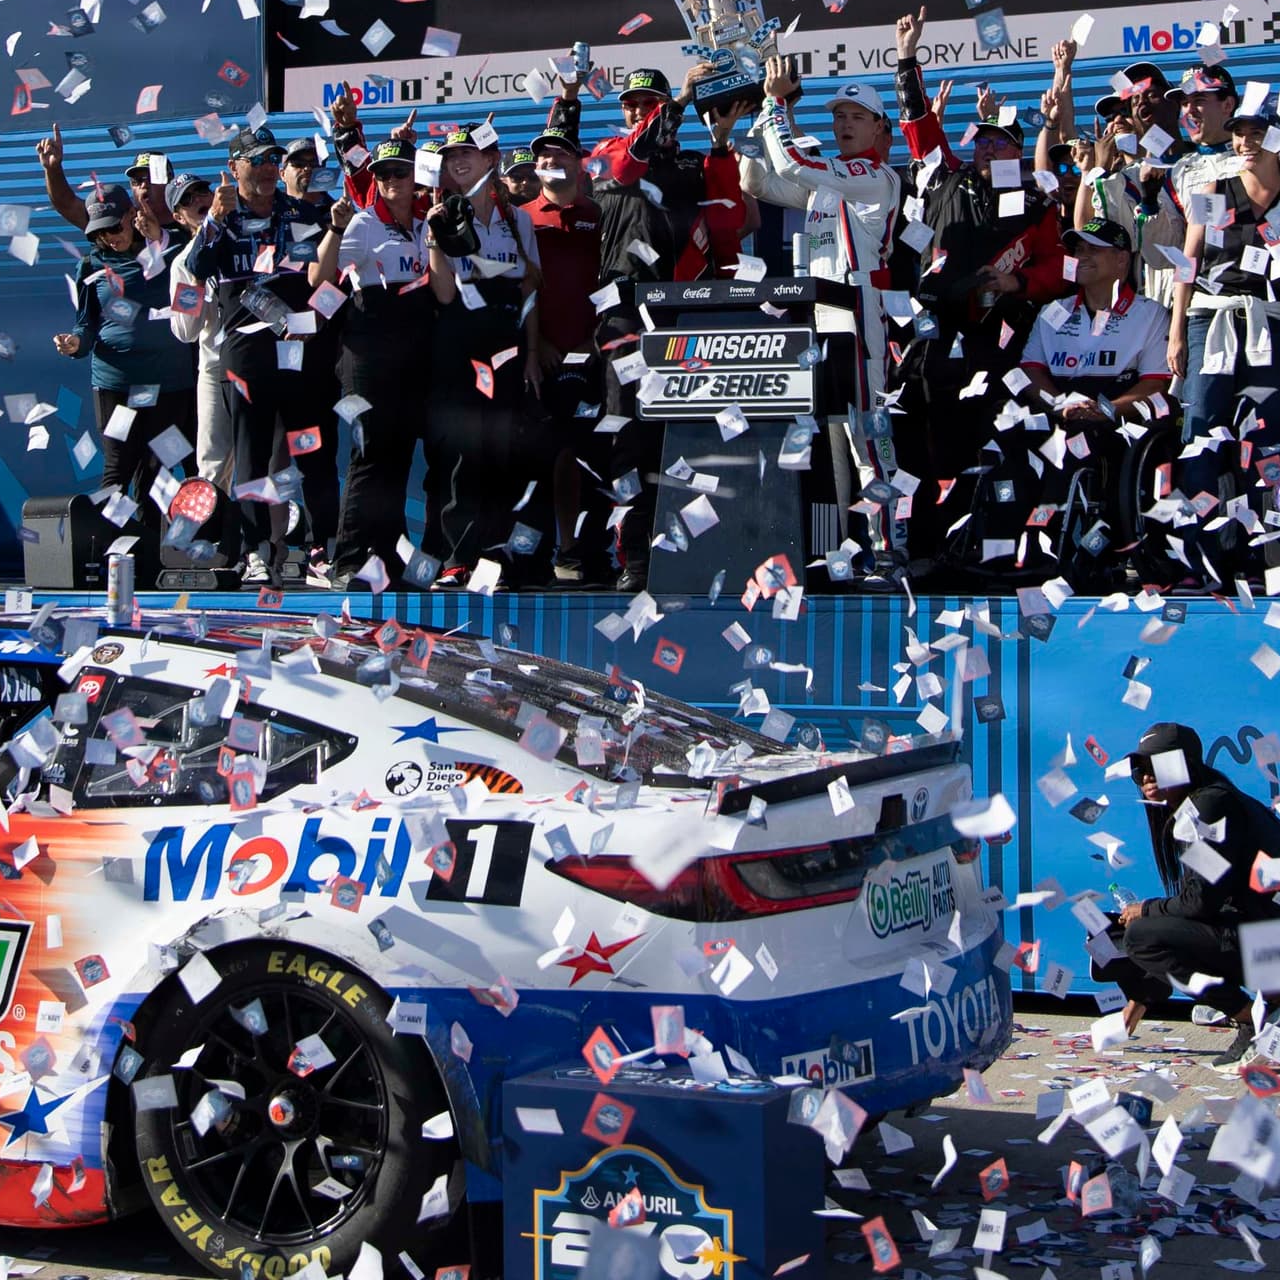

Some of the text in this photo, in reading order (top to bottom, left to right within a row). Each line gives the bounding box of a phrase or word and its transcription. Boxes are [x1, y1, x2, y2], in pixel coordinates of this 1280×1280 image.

[858, 36, 1039, 70] VICORY LANE
[323, 80, 394, 108] Mobil
[464, 70, 560, 97] VICTOY
[773, 284, 804, 297] xfinity
[695, 334, 787, 360] NASCAR
[1051, 351, 1097, 368] Mobil
[663, 373, 790, 399] CUP SERIES
[427, 771, 464, 783] Diego
[428, 761, 453, 771] San
[143, 816, 413, 902] Mobil
[870, 860, 950, 931] OReilly AUTO
[933, 887, 956, 919] PARTS
[266, 950, 368, 1009] EAGLE
[900, 975, 1002, 1065] TOYOTA
[603, 1190, 683, 1217] ANURIL
[550, 1211, 716, 1280] 20
